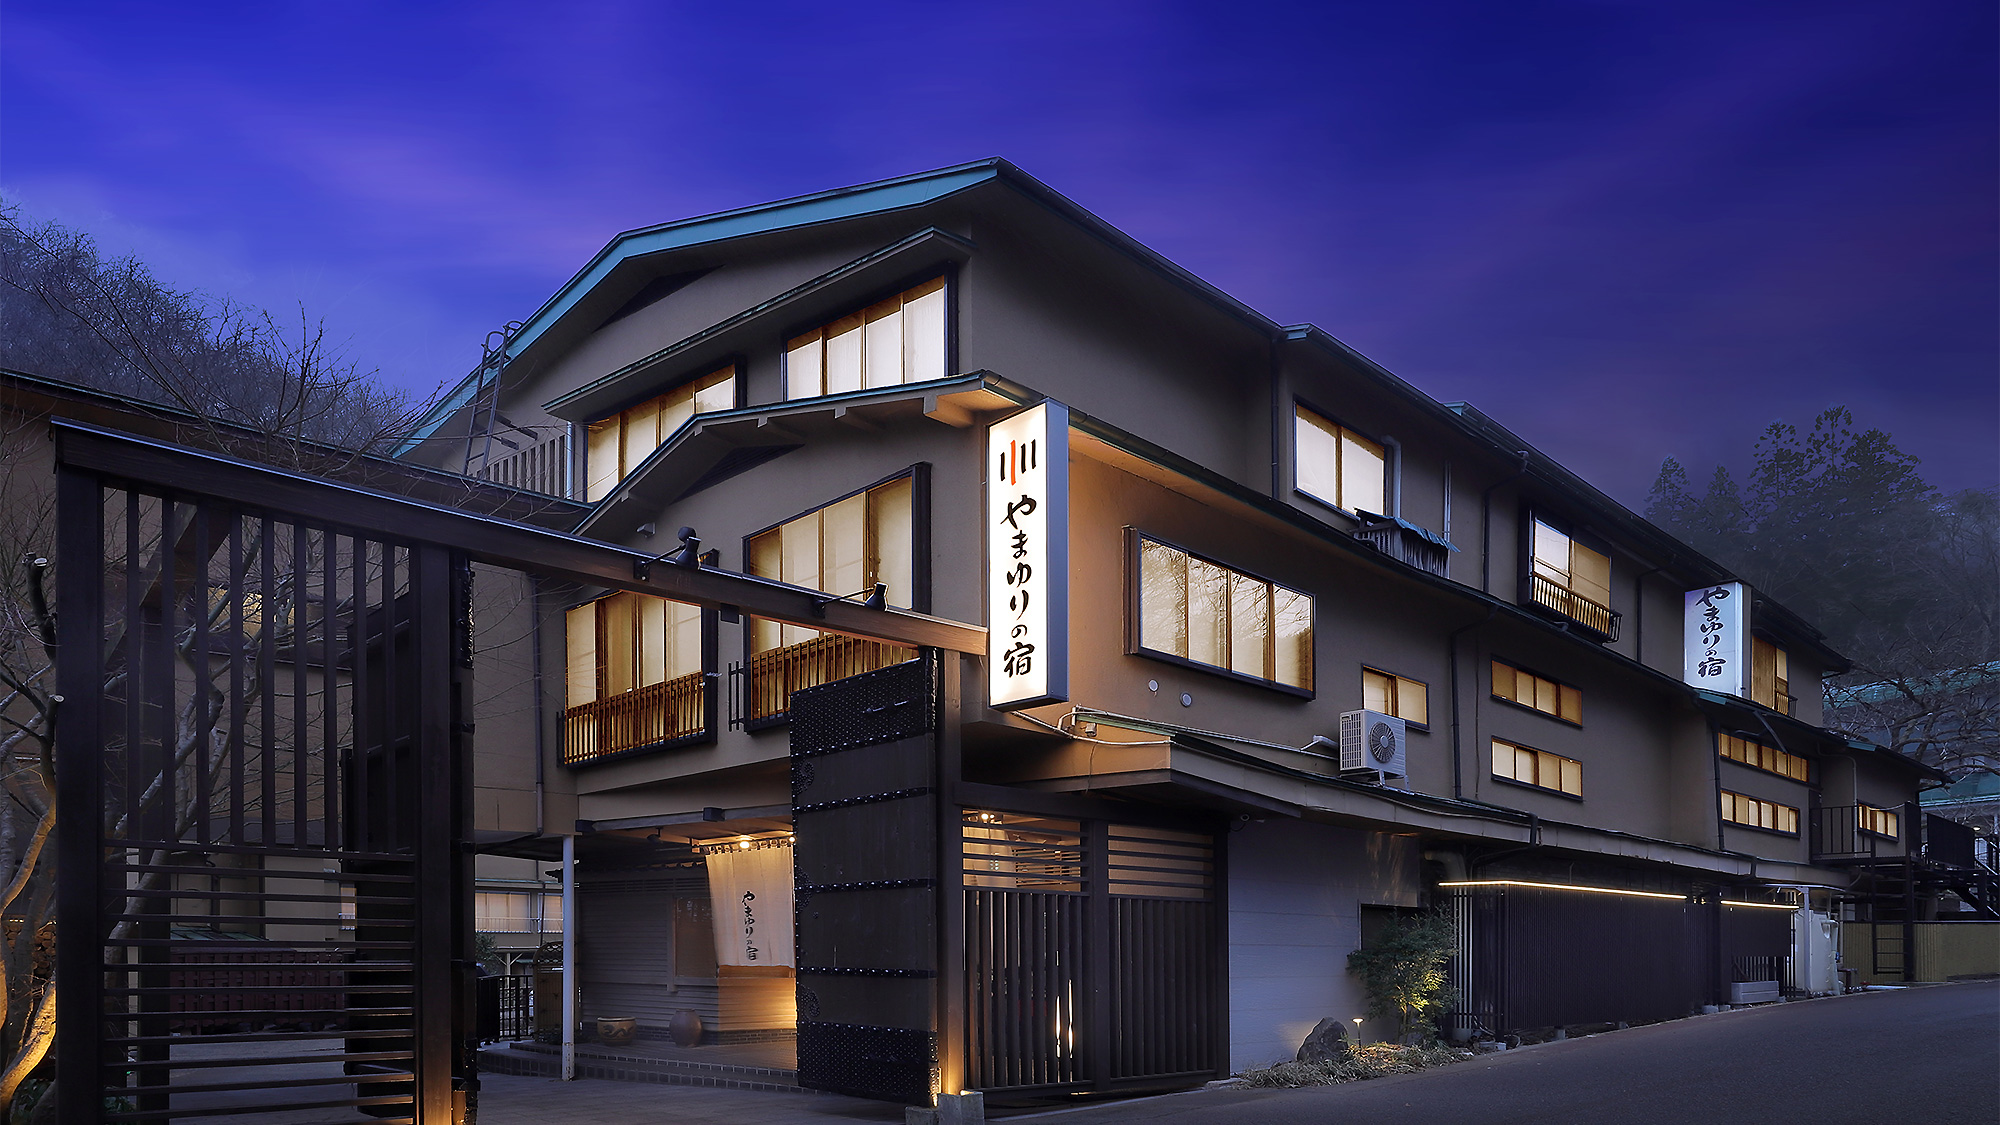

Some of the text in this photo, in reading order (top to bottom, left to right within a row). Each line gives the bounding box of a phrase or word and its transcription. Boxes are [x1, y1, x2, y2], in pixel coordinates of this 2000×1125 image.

[1000, 494, 1037, 678] やまゆりの宿
[1695, 586, 1731, 678] やまゆりの宿
